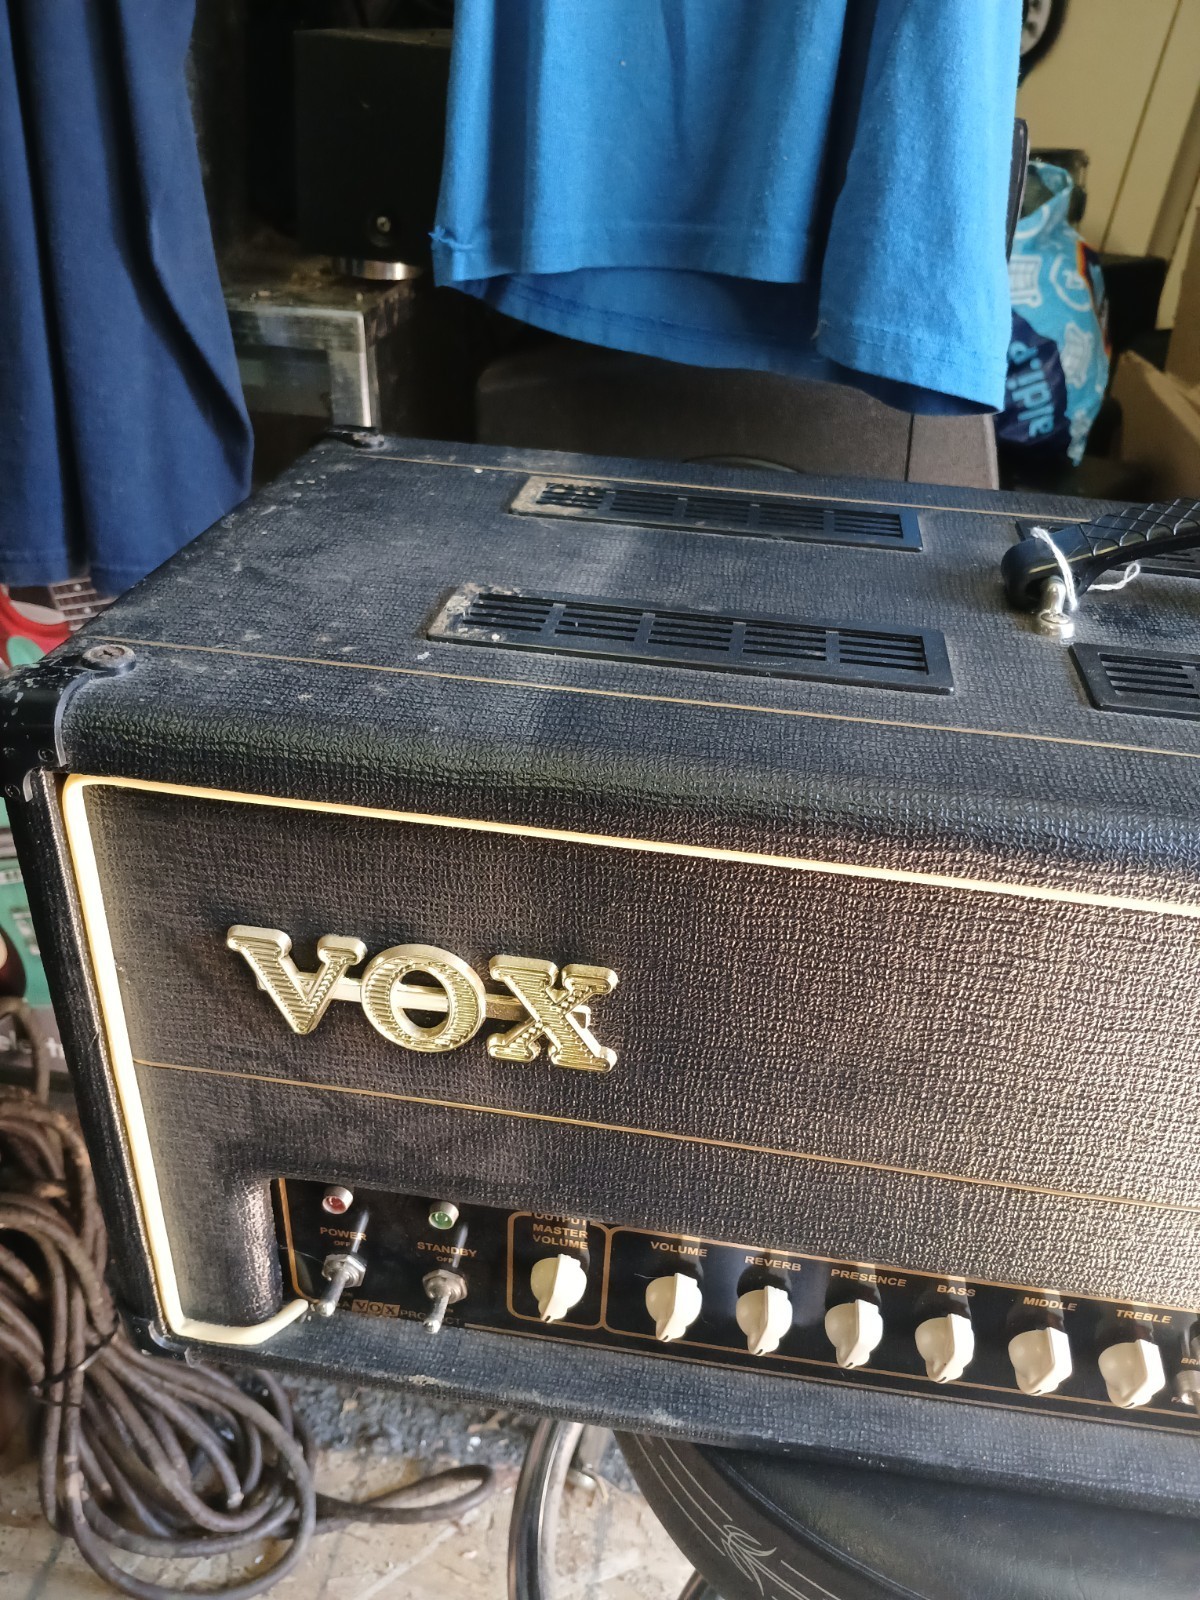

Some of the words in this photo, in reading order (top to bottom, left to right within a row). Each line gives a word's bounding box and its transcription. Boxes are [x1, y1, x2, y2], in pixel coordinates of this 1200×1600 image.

[227, 925, 618, 1072] VOX
[320, 1226, 367, 1241] POWER
[532, 1223, 588, 1239] MASTER
[417, 1242, 478, 1258] STANDBY
[532, 1234, 588, 1250] VOLUME
[650, 1241, 708, 1257] VOLUME
[744, 1255, 801, 1271] REVERB
[830, 1268, 907, 1287] PRESENCE
[937, 1284, 976, 1297] BASS
[1023, 1296, 1078, 1312] MIDDLE
[353, 1300, 399, 1317] VOX
[400, 1309, 460, 1326] PROCT
[1115, 1308, 1172, 1325] TREBLE
